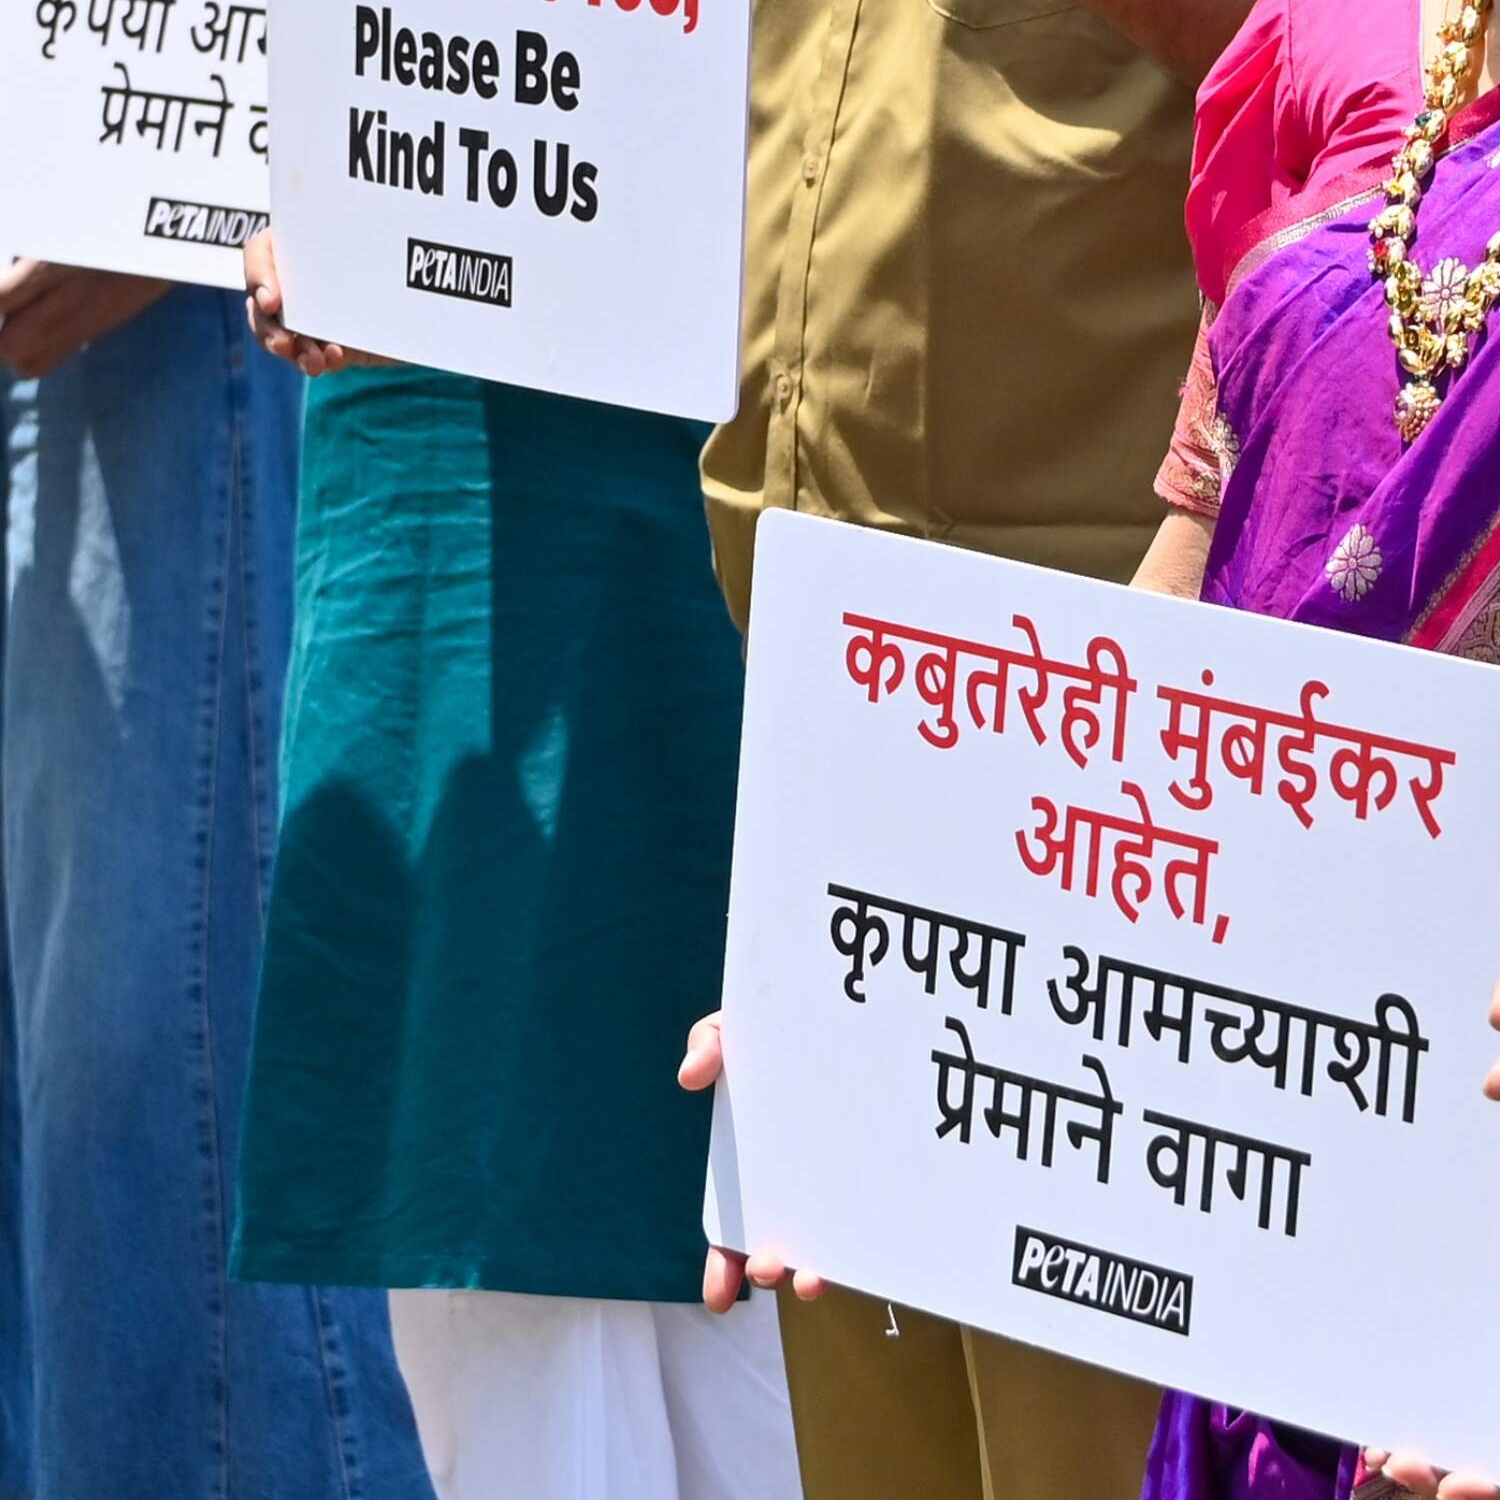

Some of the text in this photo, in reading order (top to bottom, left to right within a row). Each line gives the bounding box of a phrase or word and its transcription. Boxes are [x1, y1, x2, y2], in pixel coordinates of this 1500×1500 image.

[99, 61, 234, 158] प्रेमाने
[354, 4, 500, 100] Please
[514, 29, 581, 112] Be
[348, 106, 446, 197] Kind
[458, 126, 518, 209] To
[533, 138, 599, 223] Us
[842, 612, 1458, 839] कबुतरेही मुंबईकर
[1015, 779, 1232, 945] आहेत,
[826, 882, 1431, 1125] कृपया आमच्याशी
[930, 1015, 1312, 1238] प्रेमाने वागा
